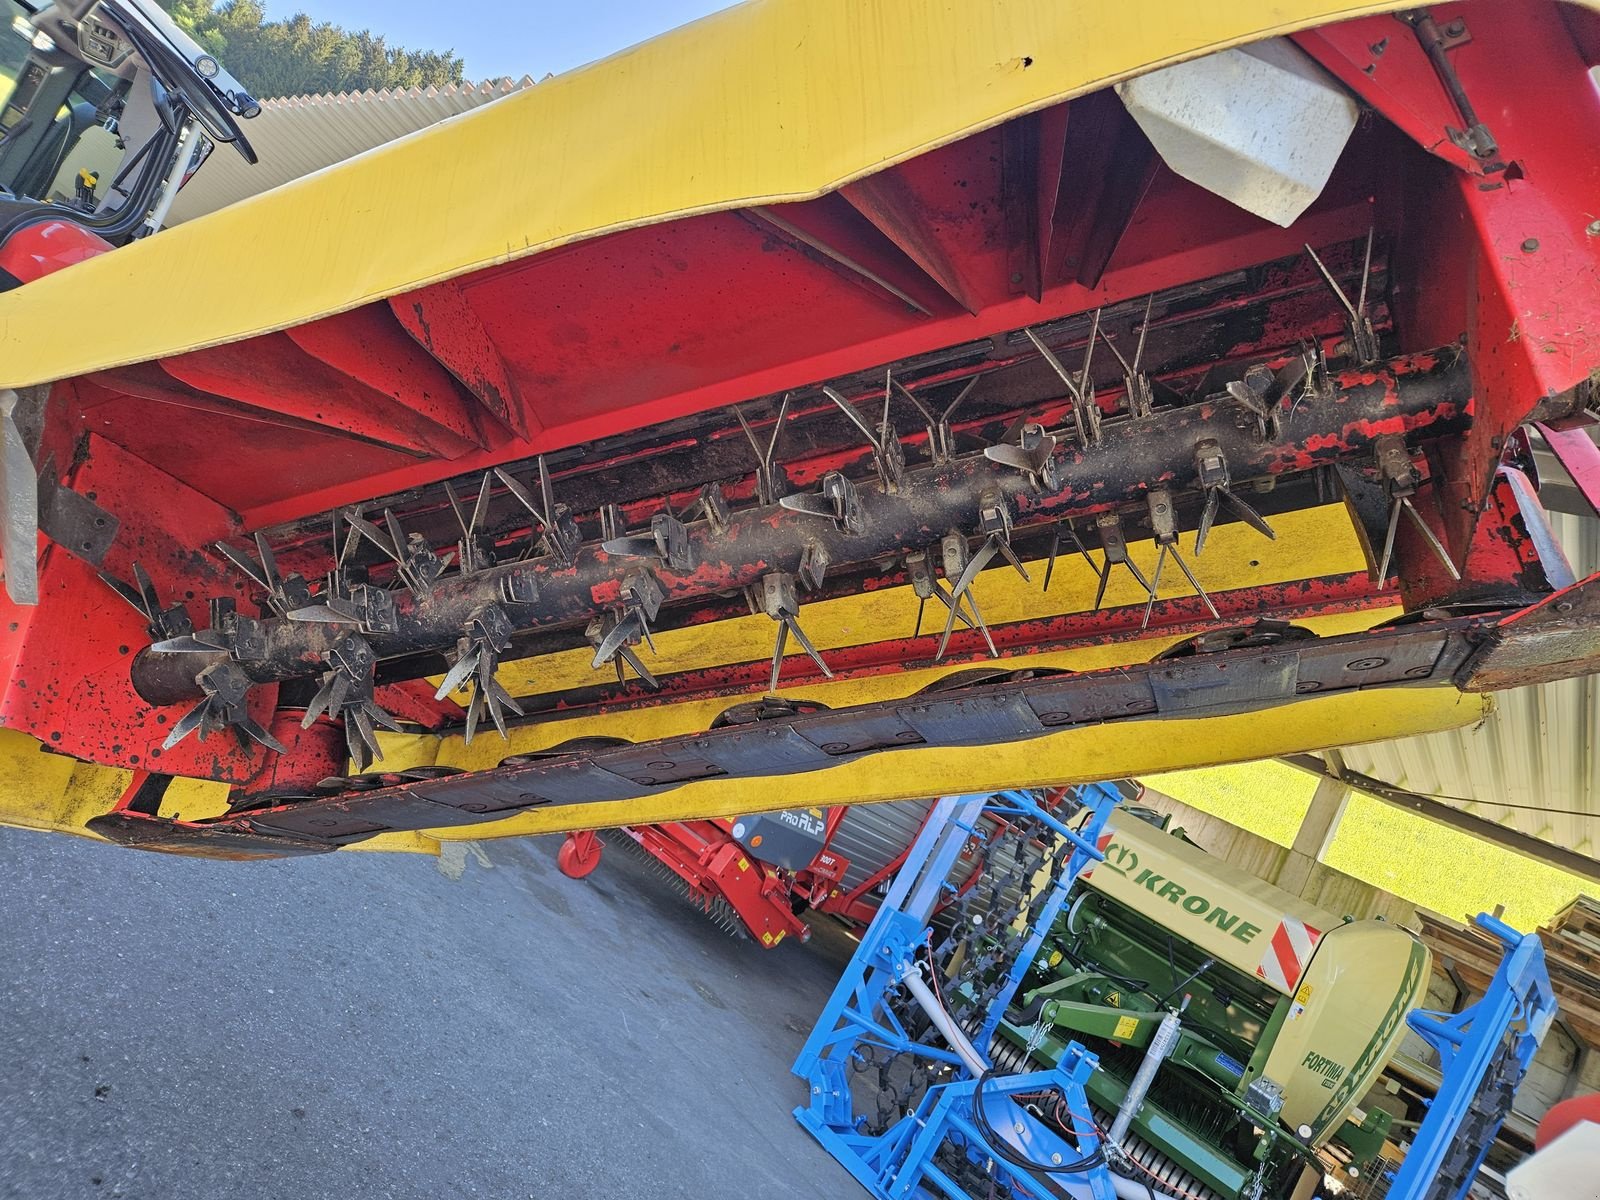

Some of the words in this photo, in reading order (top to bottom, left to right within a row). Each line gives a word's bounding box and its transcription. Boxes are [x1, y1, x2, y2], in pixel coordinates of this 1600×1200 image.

[780, 810, 799, 826] PRO
[798, 813, 825, 836] ALP
[1133, 868, 1262, 945] KRONE
[1352, 957, 1419, 1088] KRONE
[1301, 1050, 1346, 1082] FORTIMA
